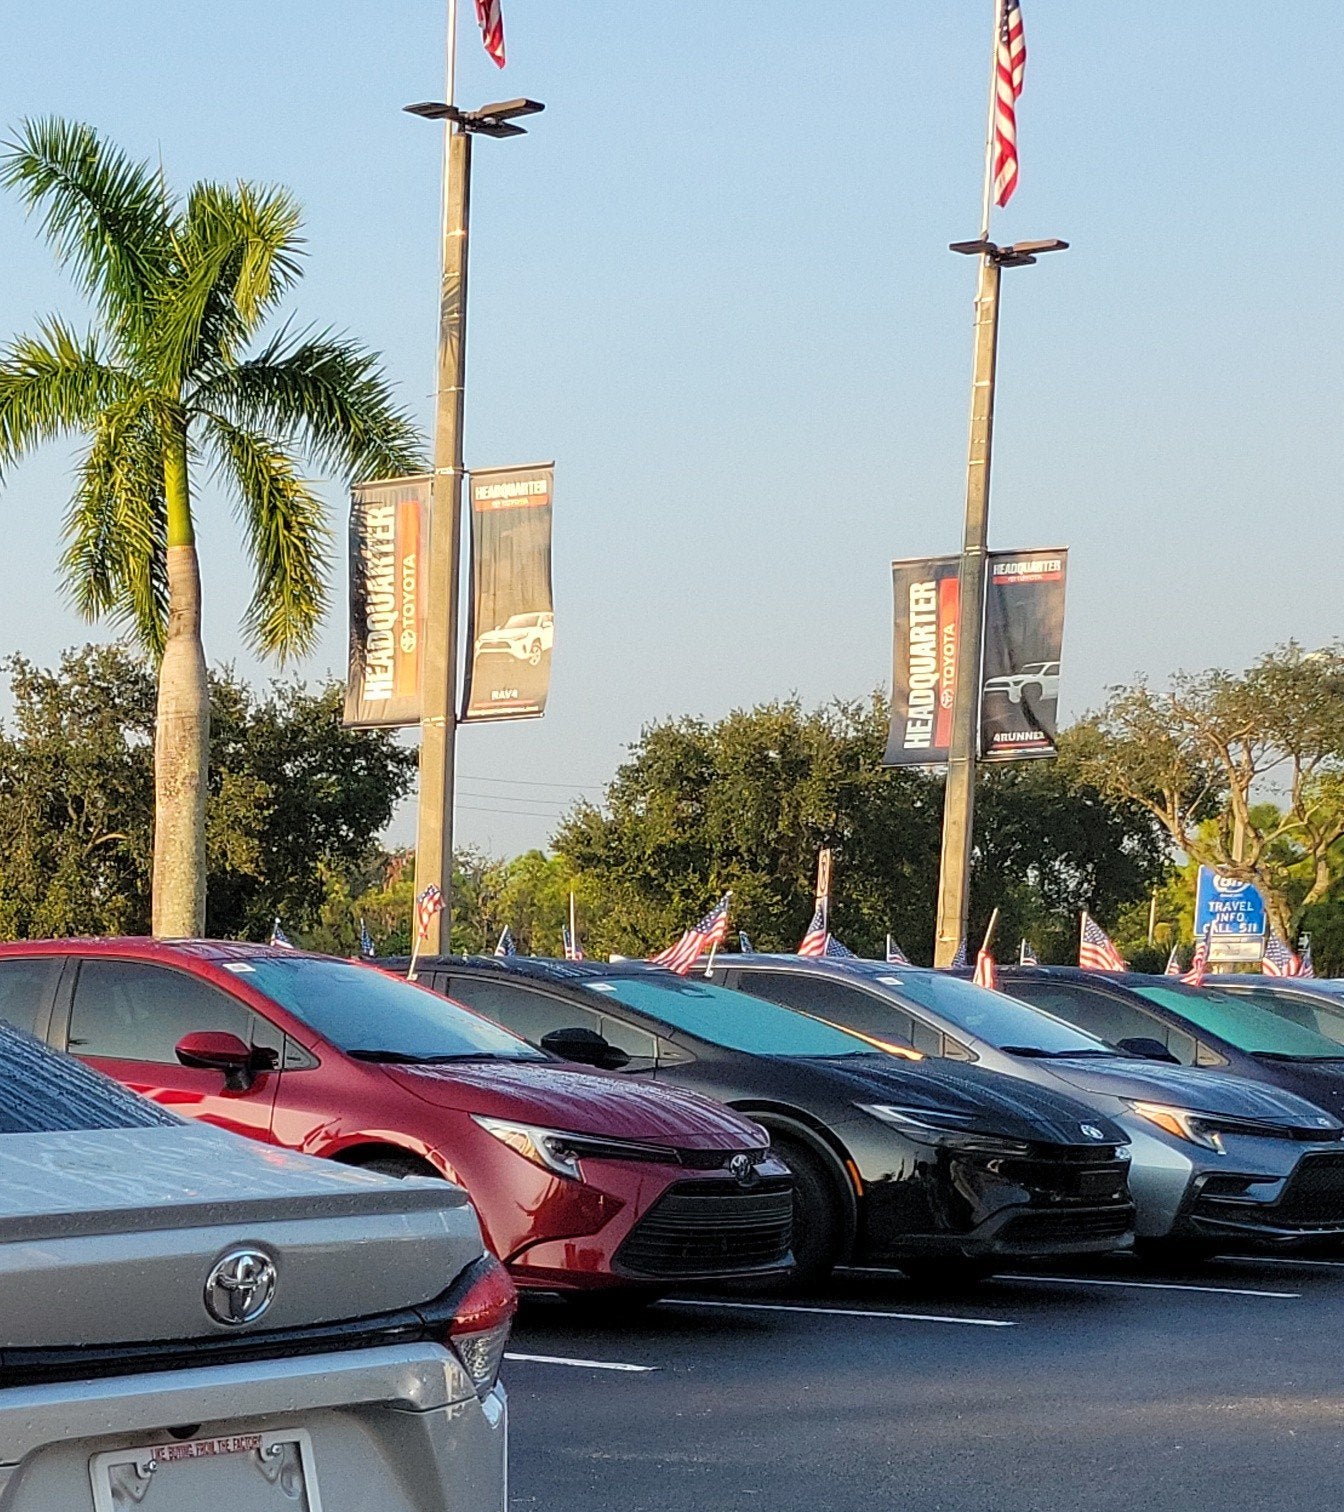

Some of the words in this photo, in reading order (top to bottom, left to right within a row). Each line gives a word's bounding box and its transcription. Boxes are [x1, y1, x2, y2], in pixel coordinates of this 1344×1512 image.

[475, 480, 547, 500] HEADQUARTER
[994, 560, 1061, 575] HEADQUARTER
[403, 553, 416, 621] TOYOTA
[363, 505, 399, 701] HEADQUARTER
[903, 580, 939, 749] HEADQUARTER
[943, 623, 956, 687] TOYOTA
[1208, 901, 1254, 912] TRAVEL
[1216, 912, 1245, 922] INFO
[1202, 922, 1232, 933] CALL
[1238, 922, 1258, 932] 511
